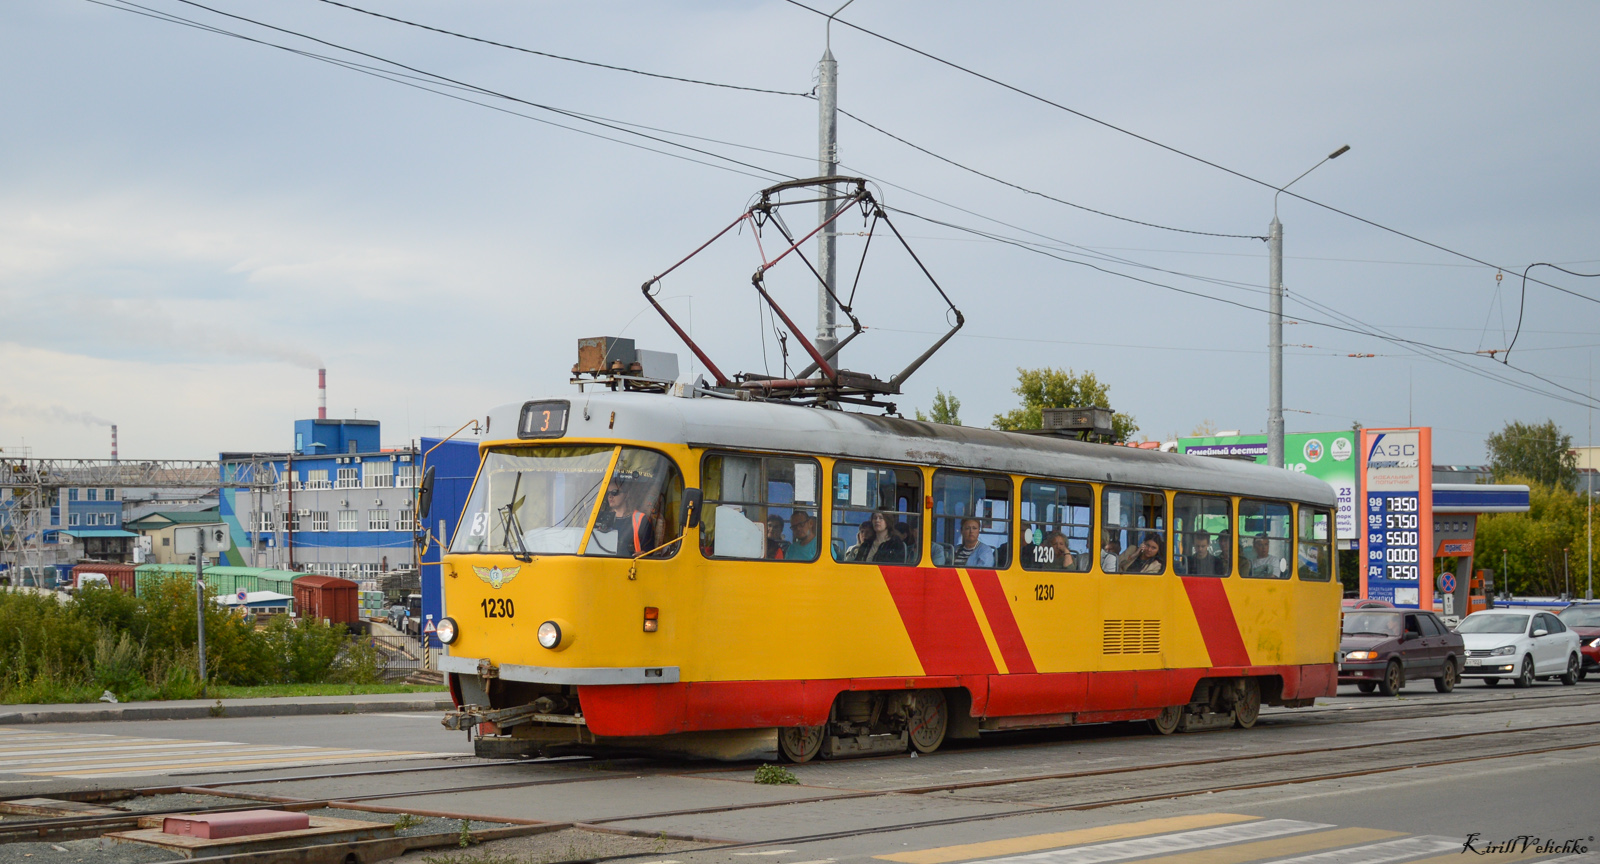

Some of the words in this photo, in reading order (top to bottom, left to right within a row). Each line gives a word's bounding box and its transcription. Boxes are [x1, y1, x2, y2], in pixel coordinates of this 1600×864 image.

[540, 410, 551, 432] 3
[1373, 444, 1415, 457] АЗС
[1340, 488, 1351, 496] 23
[1369, 497, 1383, 507] 98
[473, 513, 487, 536] 3
[1368, 514, 1383, 524] 95
[1369, 534, 1383, 543] 92
[1033, 545, 1055, 563] 1230
[1369, 550, 1383, 560] 80
[1368, 565, 1383, 576] Дт
[1034, 584, 1055, 600] 1230
[481, 598, 515, 618] 1230
